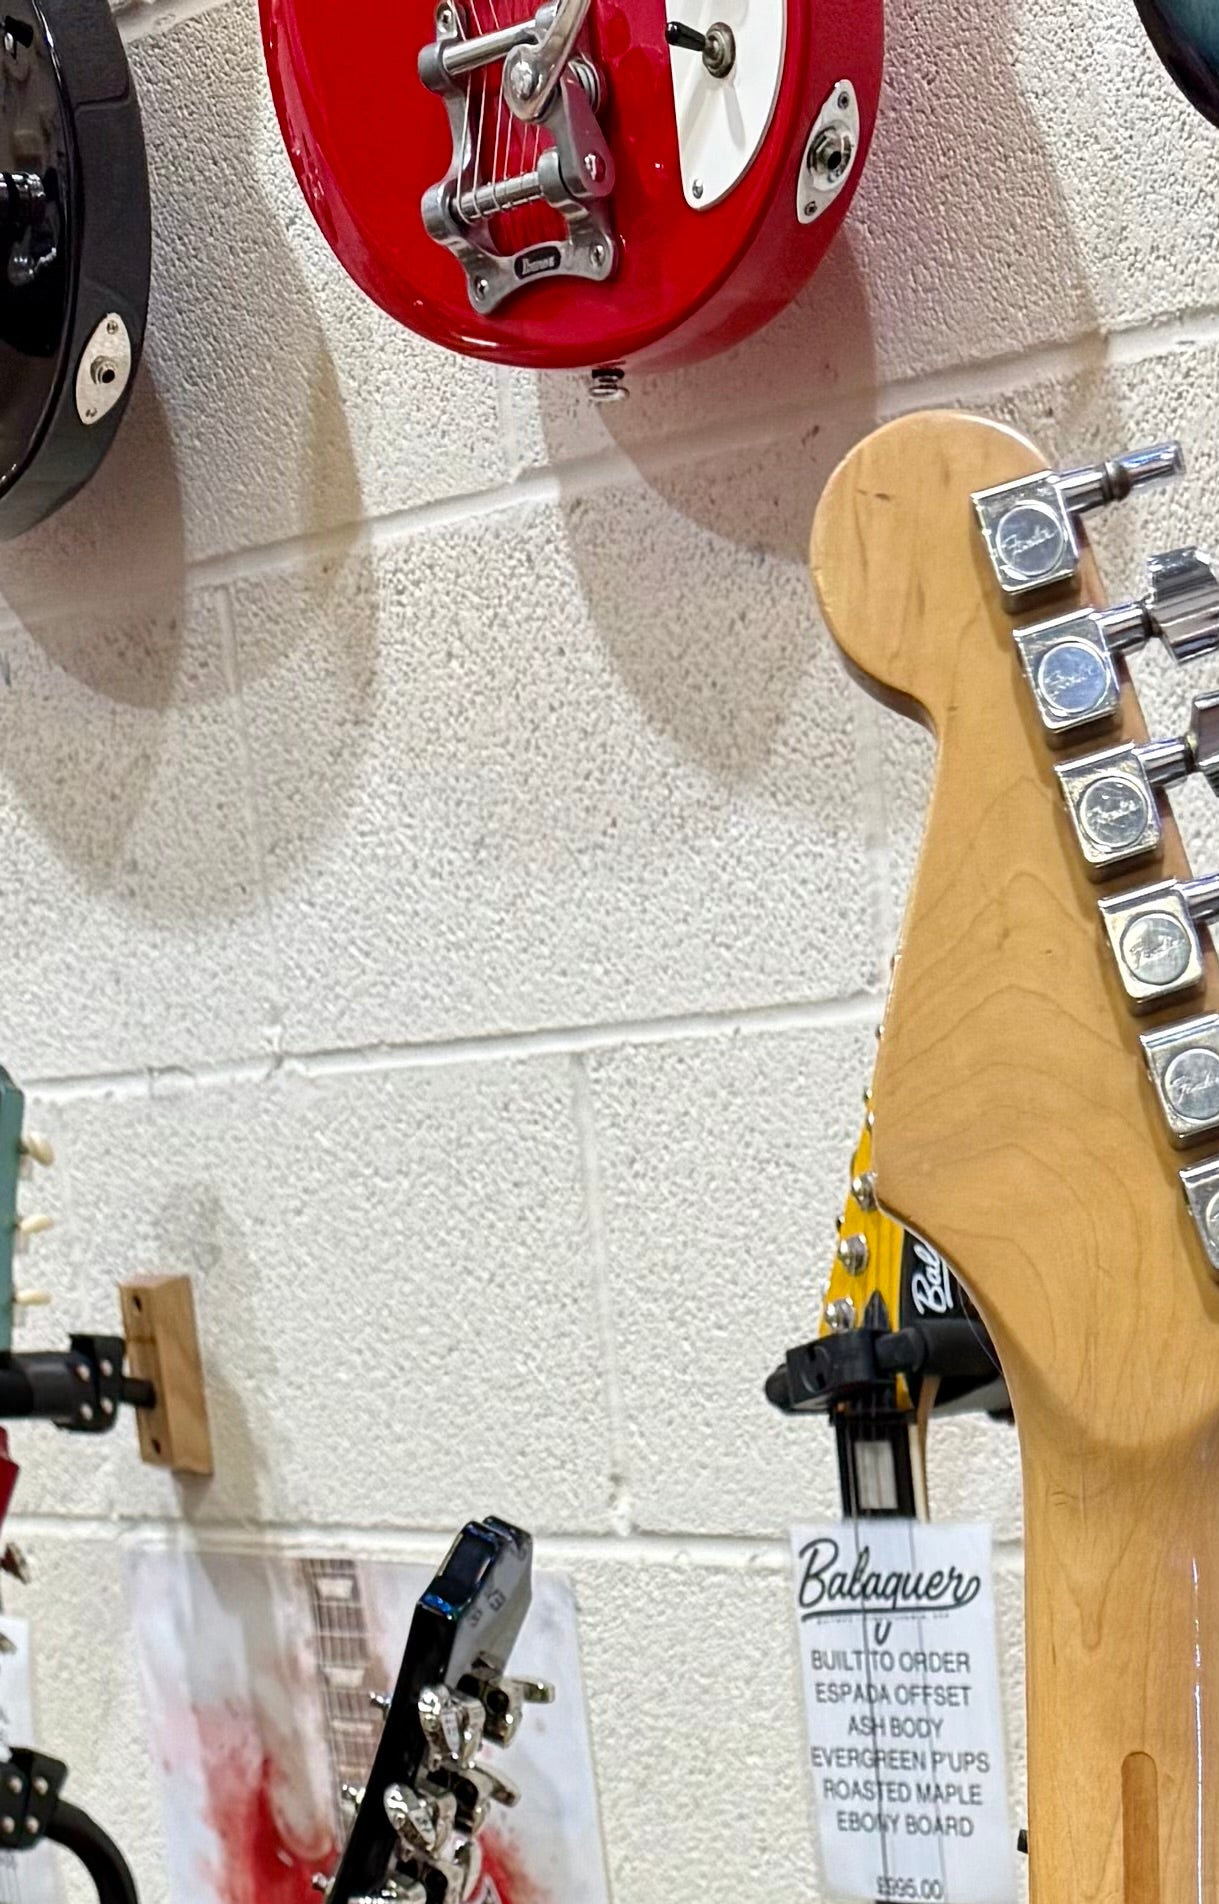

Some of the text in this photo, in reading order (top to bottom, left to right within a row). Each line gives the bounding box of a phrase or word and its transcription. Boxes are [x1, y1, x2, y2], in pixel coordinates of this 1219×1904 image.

[811, 1650, 971, 1673] BUILT TO ORDER
[814, 1683, 973, 1706] ESPADA OFFSET
[847, 1717, 944, 1739] ASH BODY
[811, 1747, 927, 1770] EVERGREEN
[823, 1779, 983, 1806] ROASTED MAPLE
[836, 1811, 974, 1837] EBONY BOARD
